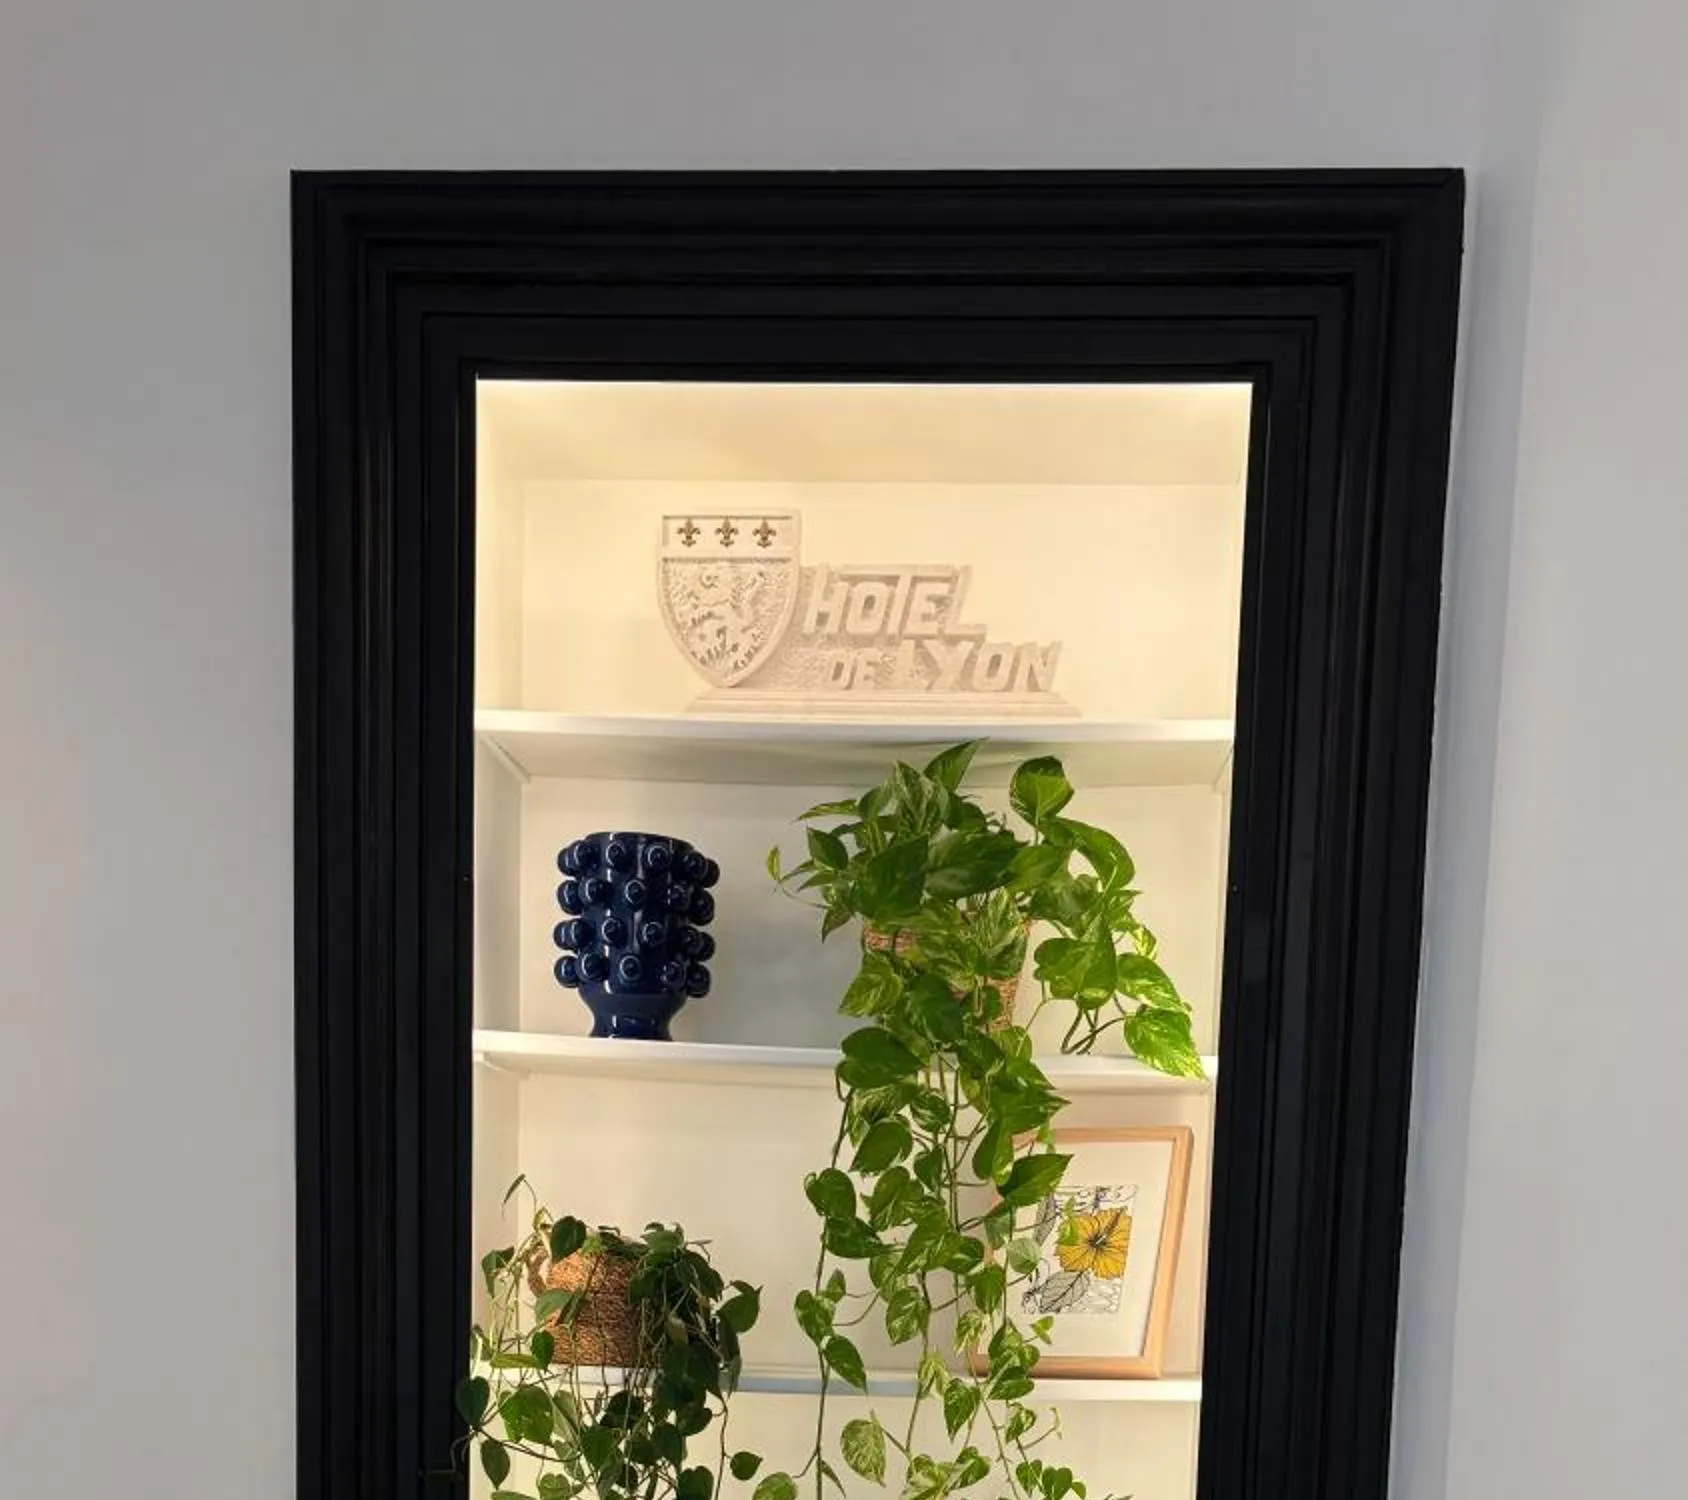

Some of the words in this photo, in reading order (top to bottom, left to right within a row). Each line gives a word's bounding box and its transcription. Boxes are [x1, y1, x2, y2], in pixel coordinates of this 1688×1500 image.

[803, 564, 988, 637] HOTEL
[830, 649, 884, 691] DE
[892, 638, 1063, 692] LYON
